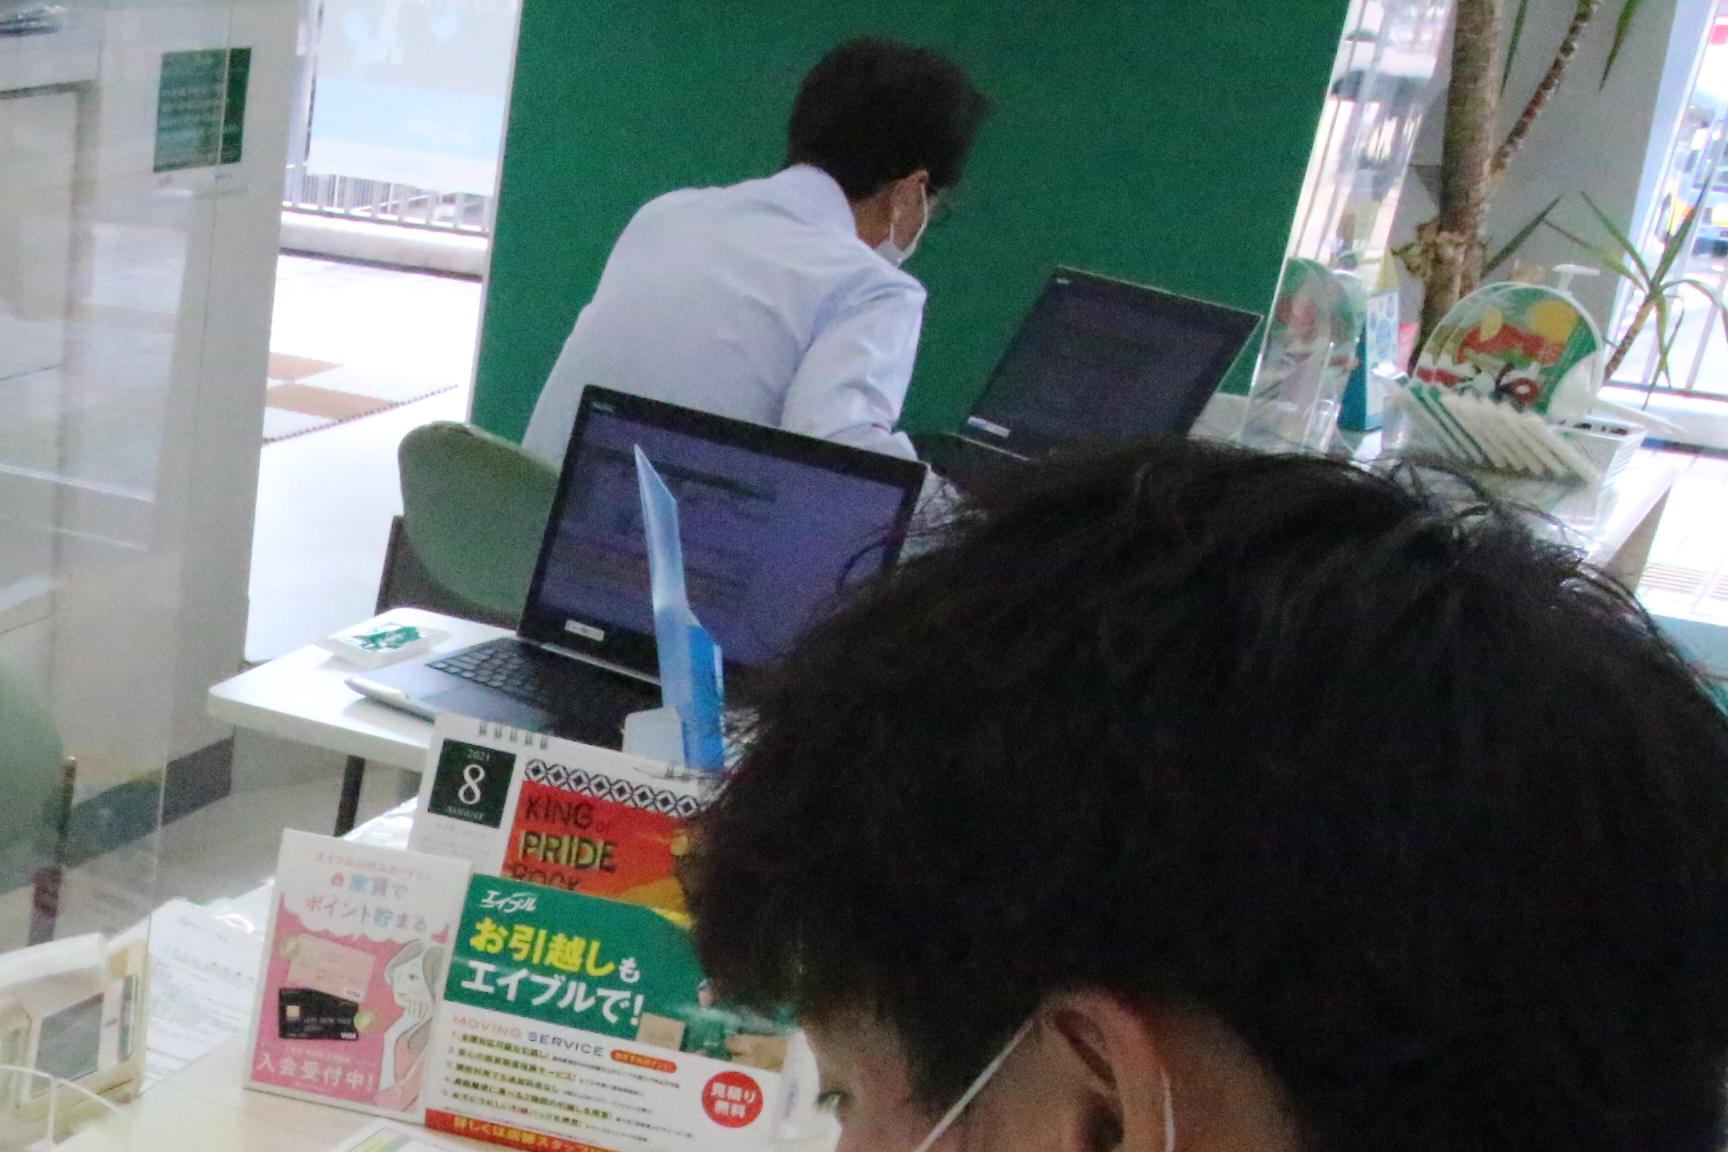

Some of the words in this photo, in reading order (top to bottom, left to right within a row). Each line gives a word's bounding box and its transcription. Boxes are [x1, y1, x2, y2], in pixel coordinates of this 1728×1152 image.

[458, 764, 485, 805] 8
[524, 795, 595, 831] KING
[520, 831, 617, 873] PRIDE
[469, 917, 642, 984] お引越しも
[527, 1031, 605, 1058] SERVICE
